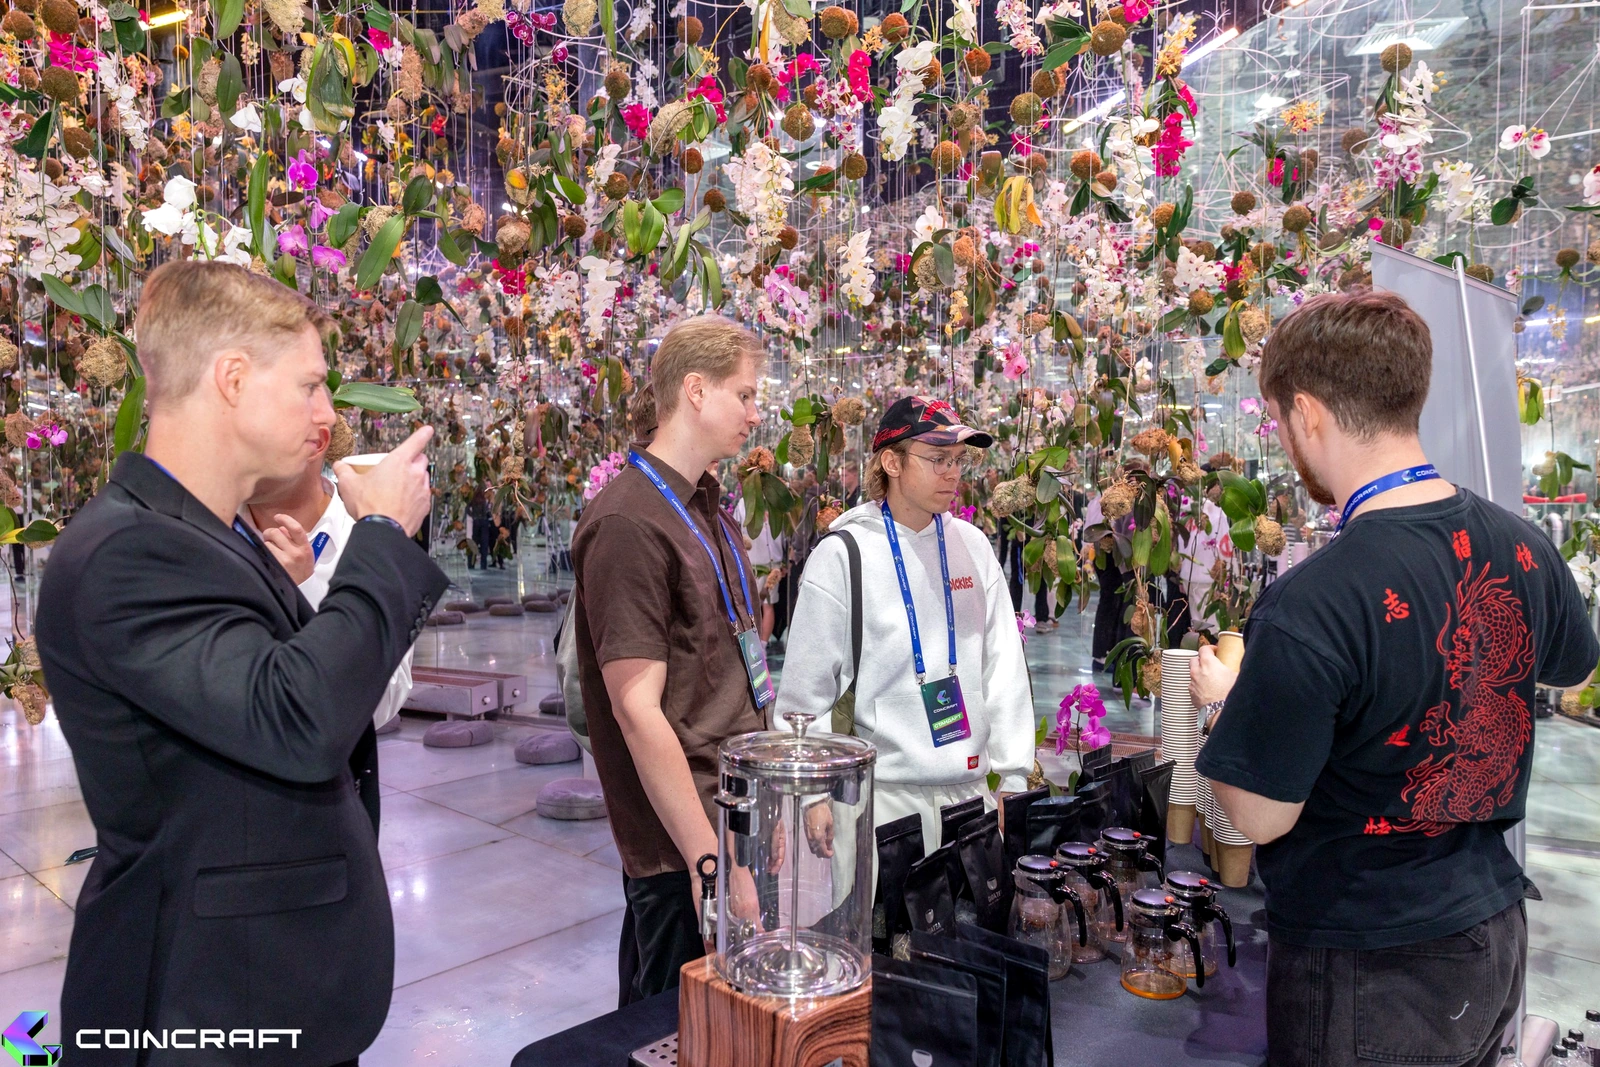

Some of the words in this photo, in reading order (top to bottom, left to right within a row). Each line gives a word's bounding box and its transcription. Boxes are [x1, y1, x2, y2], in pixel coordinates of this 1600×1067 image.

[1345, 485, 1378, 516] COINCRAFT
[1452, 529, 1472, 562] 福
[1383, 588, 1410, 624] 志
[934, 713, 962, 729] СТАНДАРТ
